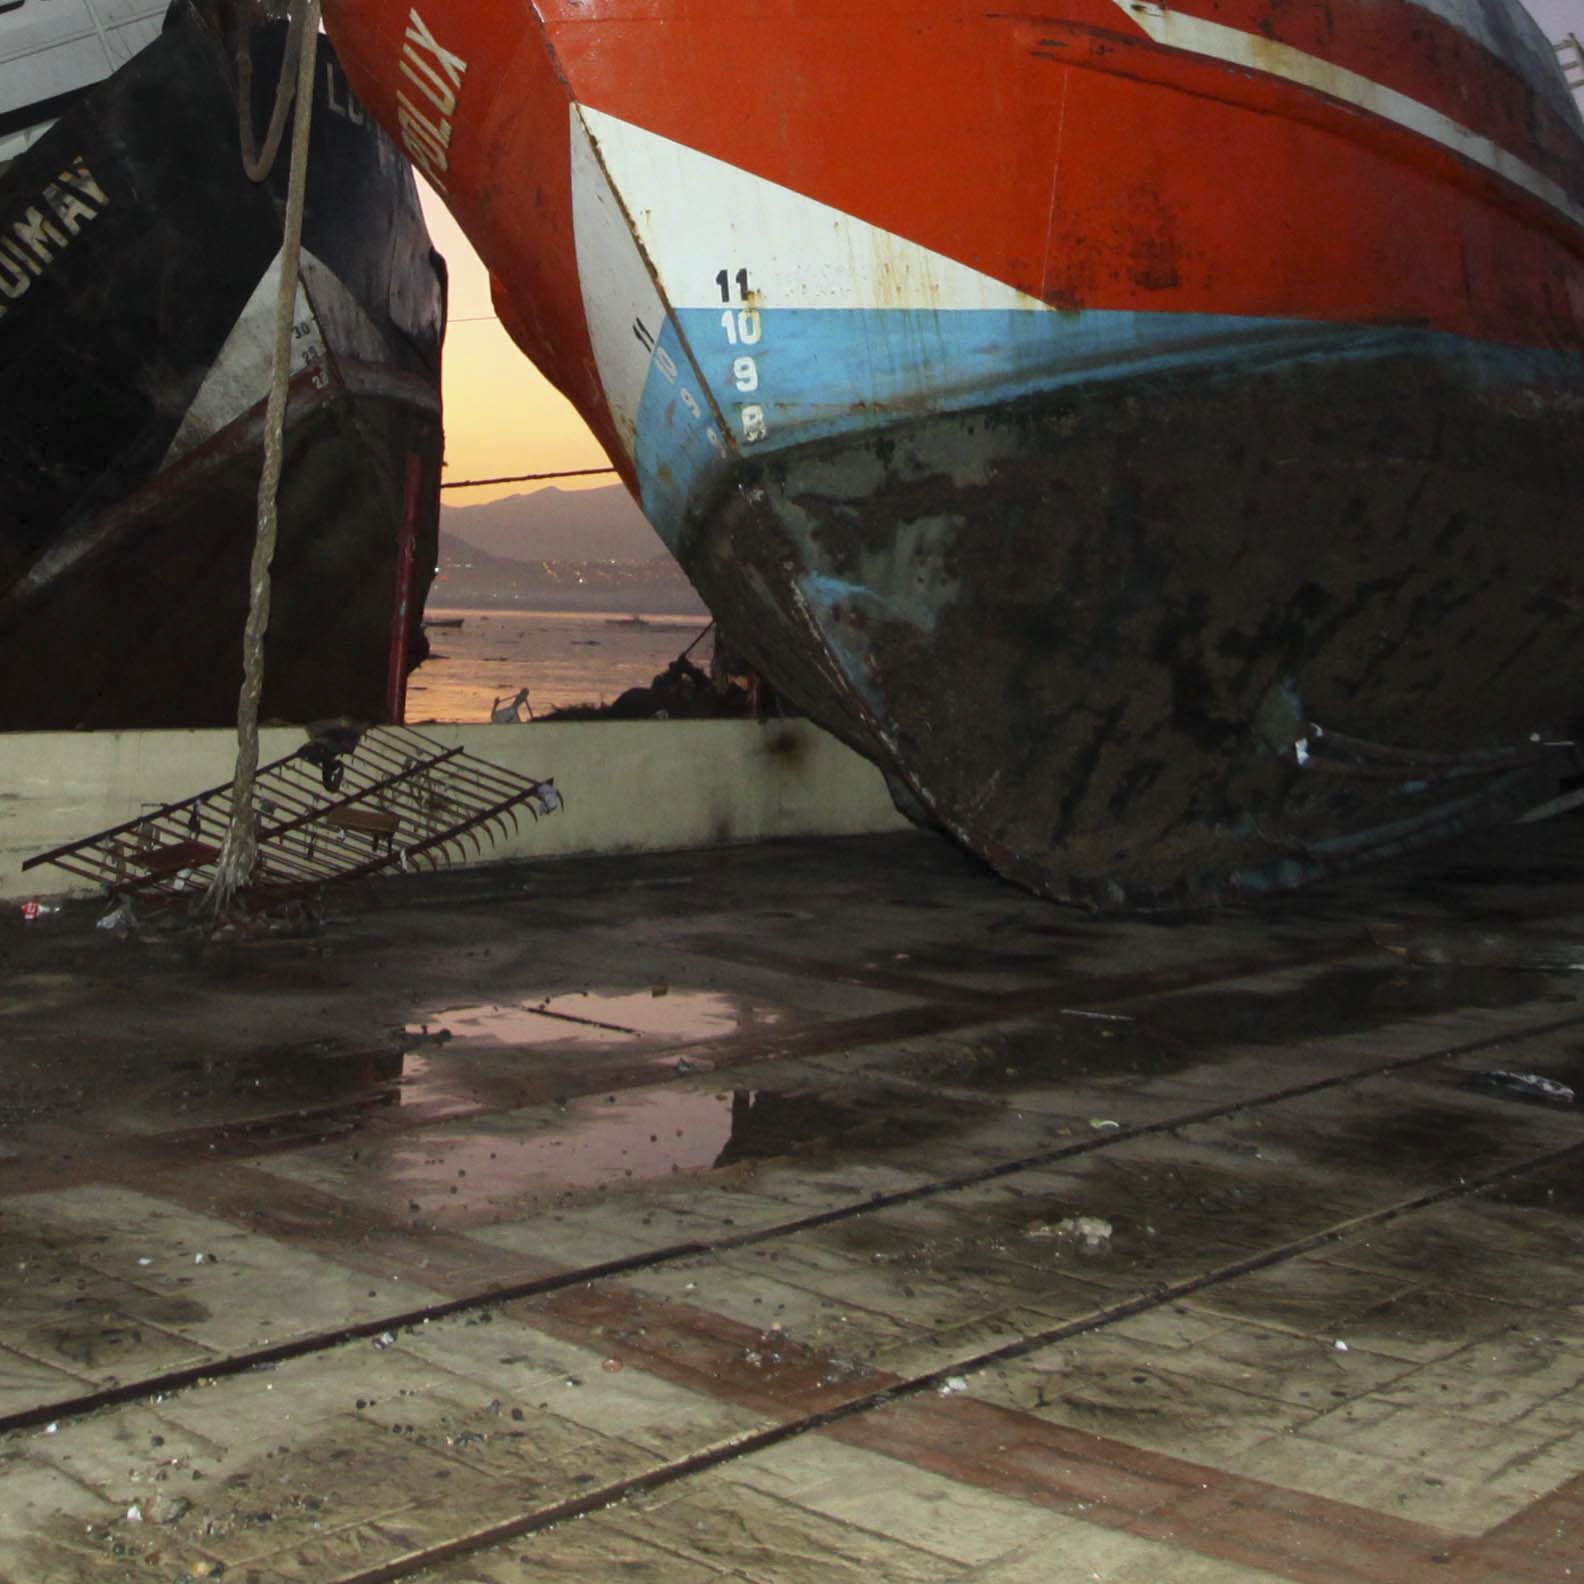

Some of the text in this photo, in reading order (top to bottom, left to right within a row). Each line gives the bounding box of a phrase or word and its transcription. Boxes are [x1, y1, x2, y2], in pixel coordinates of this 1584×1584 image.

[715, 267, 750, 303] 11
[720, 309, 762, 345] 10
[732, 355, 759, 393] 9
